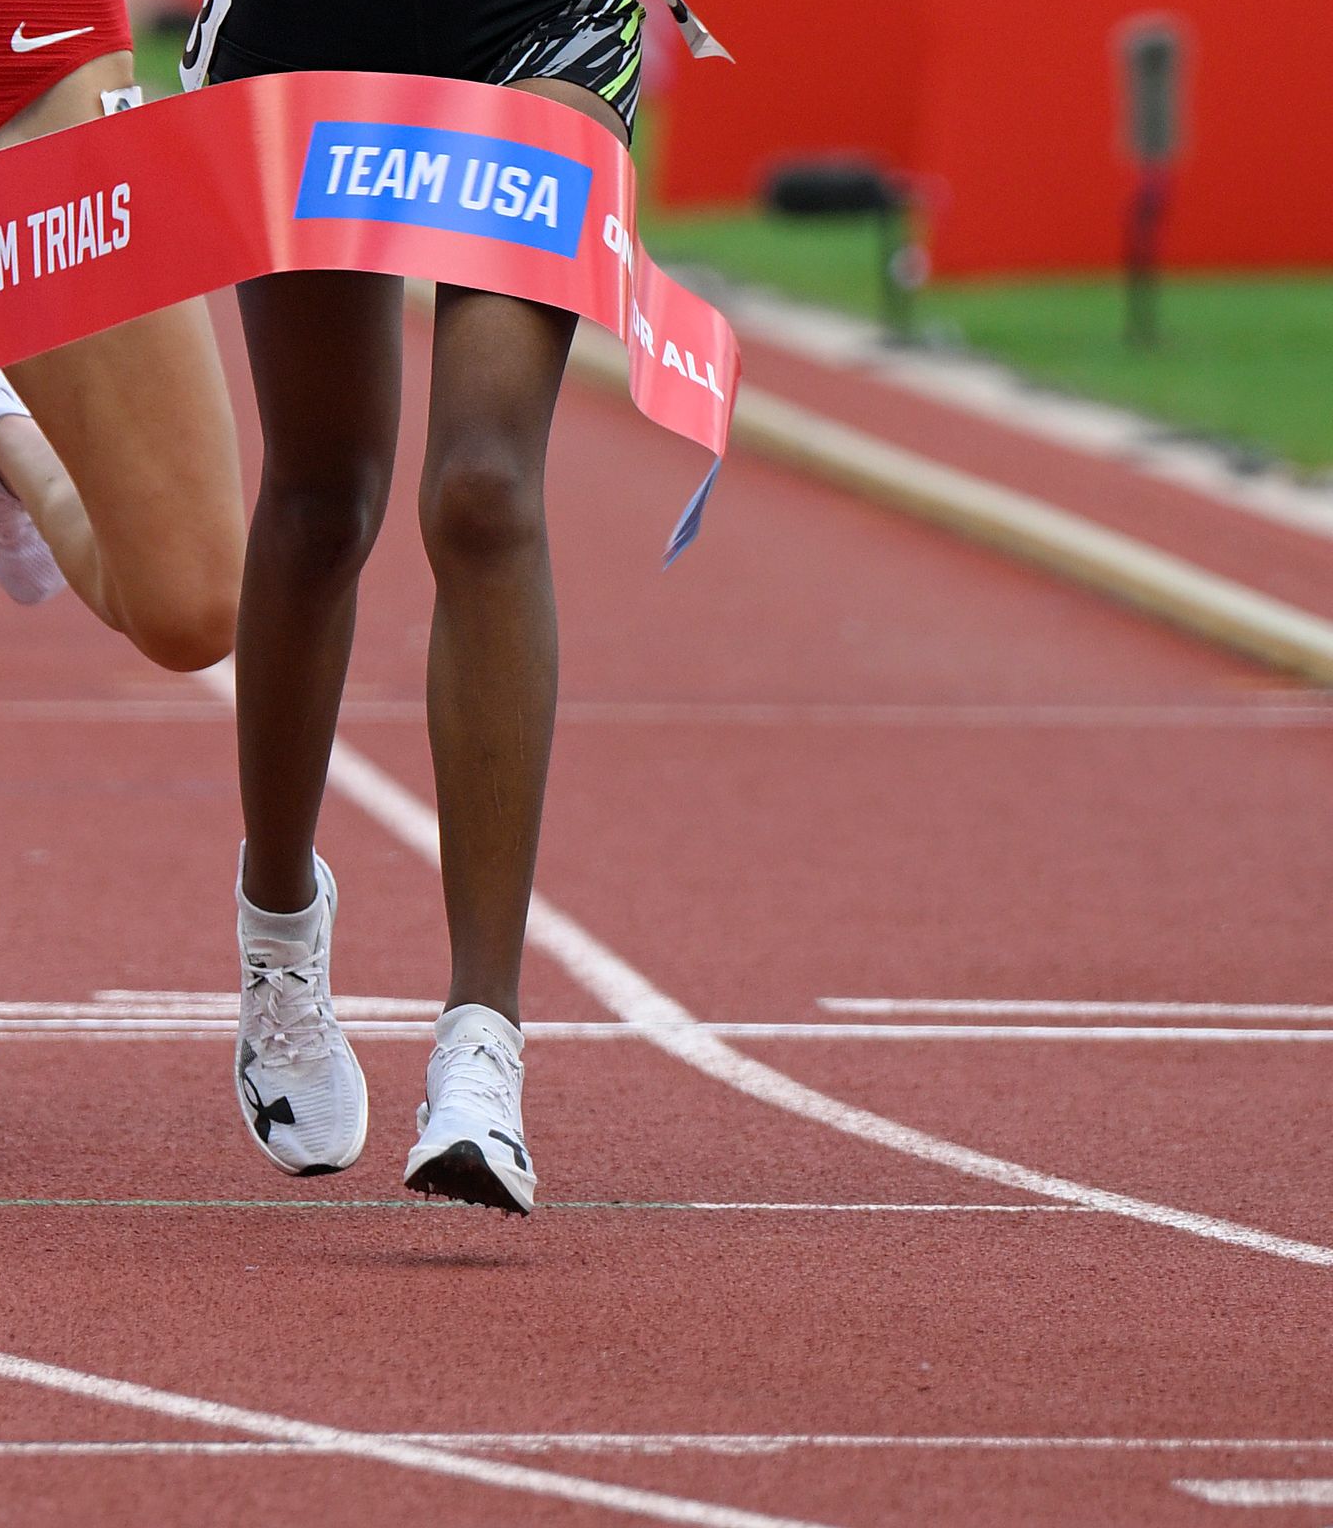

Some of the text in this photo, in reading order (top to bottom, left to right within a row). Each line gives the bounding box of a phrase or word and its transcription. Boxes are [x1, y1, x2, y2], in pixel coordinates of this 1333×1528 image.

[27, 182, 131, 279] TRIALS
[325, 145, 560, 230] TEAM USA
[602, 213, 724, 403] ON OR ALL
